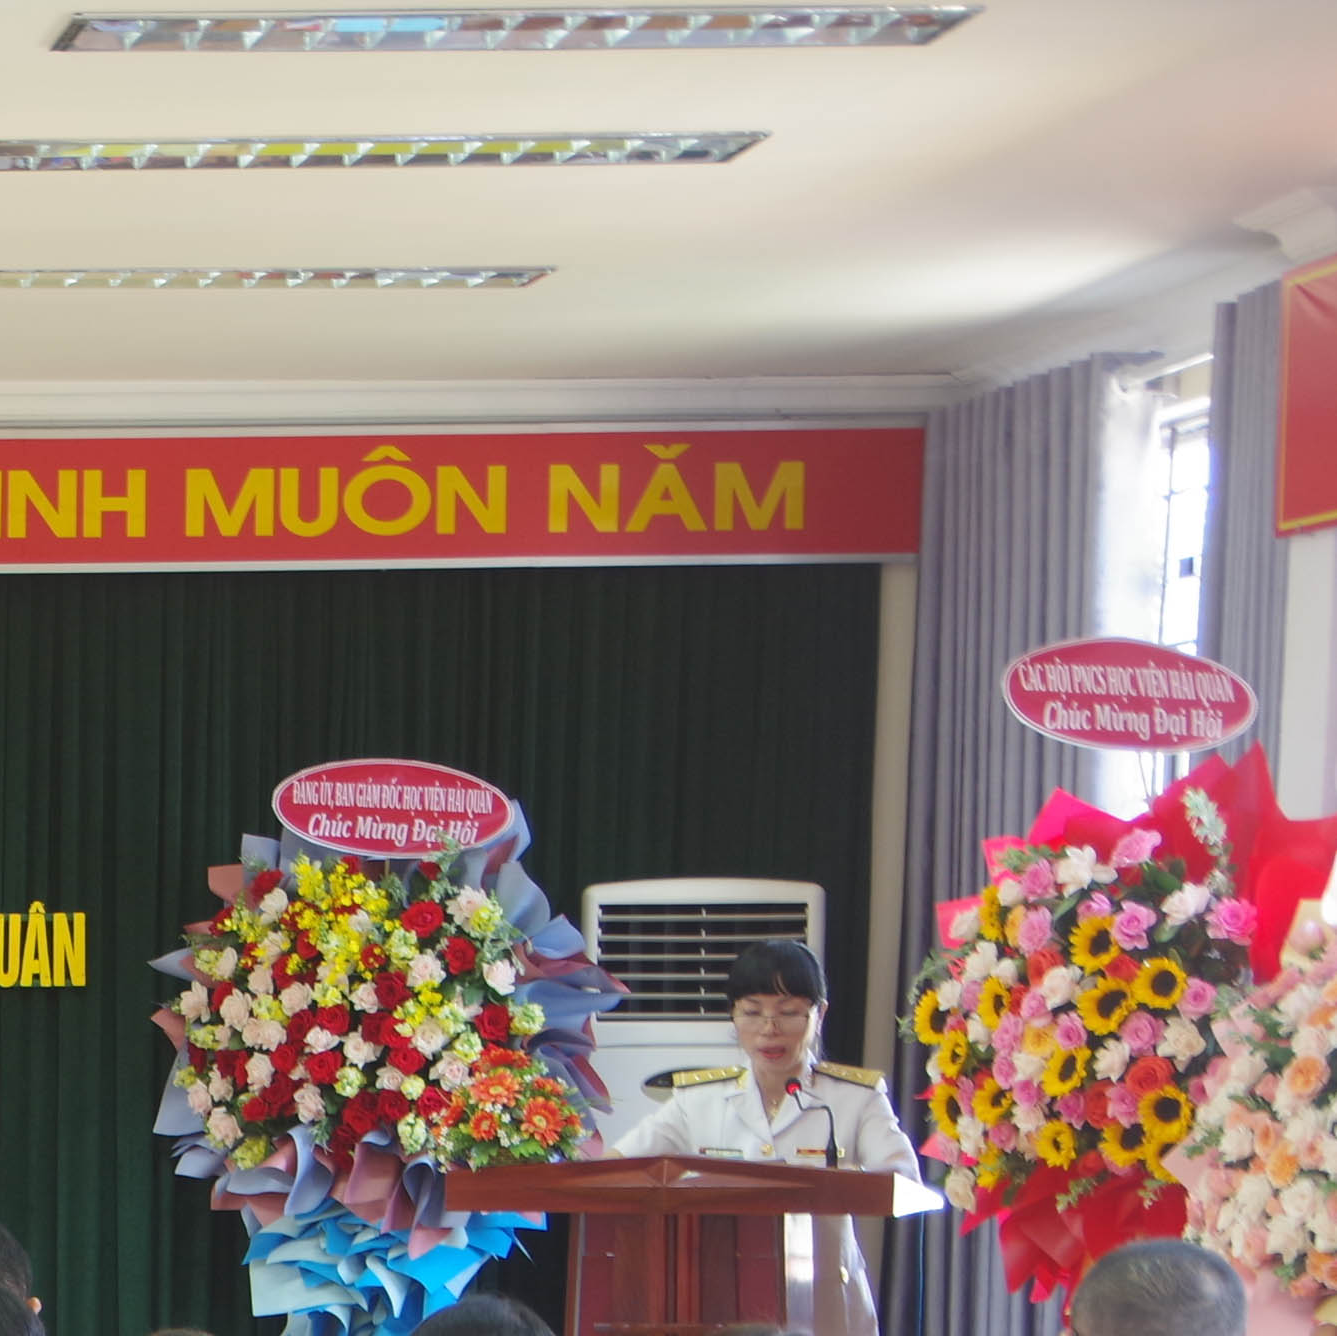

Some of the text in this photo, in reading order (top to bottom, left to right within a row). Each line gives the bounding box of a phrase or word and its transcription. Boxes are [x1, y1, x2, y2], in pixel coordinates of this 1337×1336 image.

[185, 445, 507, 538] MUÔN
[547, 443, 806, 533] NĂM
[1017, 657, 1047, 692] CÁC
[1106, 665, 1138, 703] HỌC
[1135, 660, 1169, 705] VIỆN
[1044, 700, 1092, 731] Chúc
[1093, 703, 1151, 741] Mừng
[1153, 706, 1188, 743] Đại
[292, 775, 319, 806] ĐẢNG
[335, 781, 356, 807] BAN
[356, 777, 381, 809] GIÁM
[403, 785, 424, 817] HỌC
[424, 780, 447, 818] VIỆN
[308, 812, 353, 838] Chúc
[354, 815, 409, 847] Mừng
